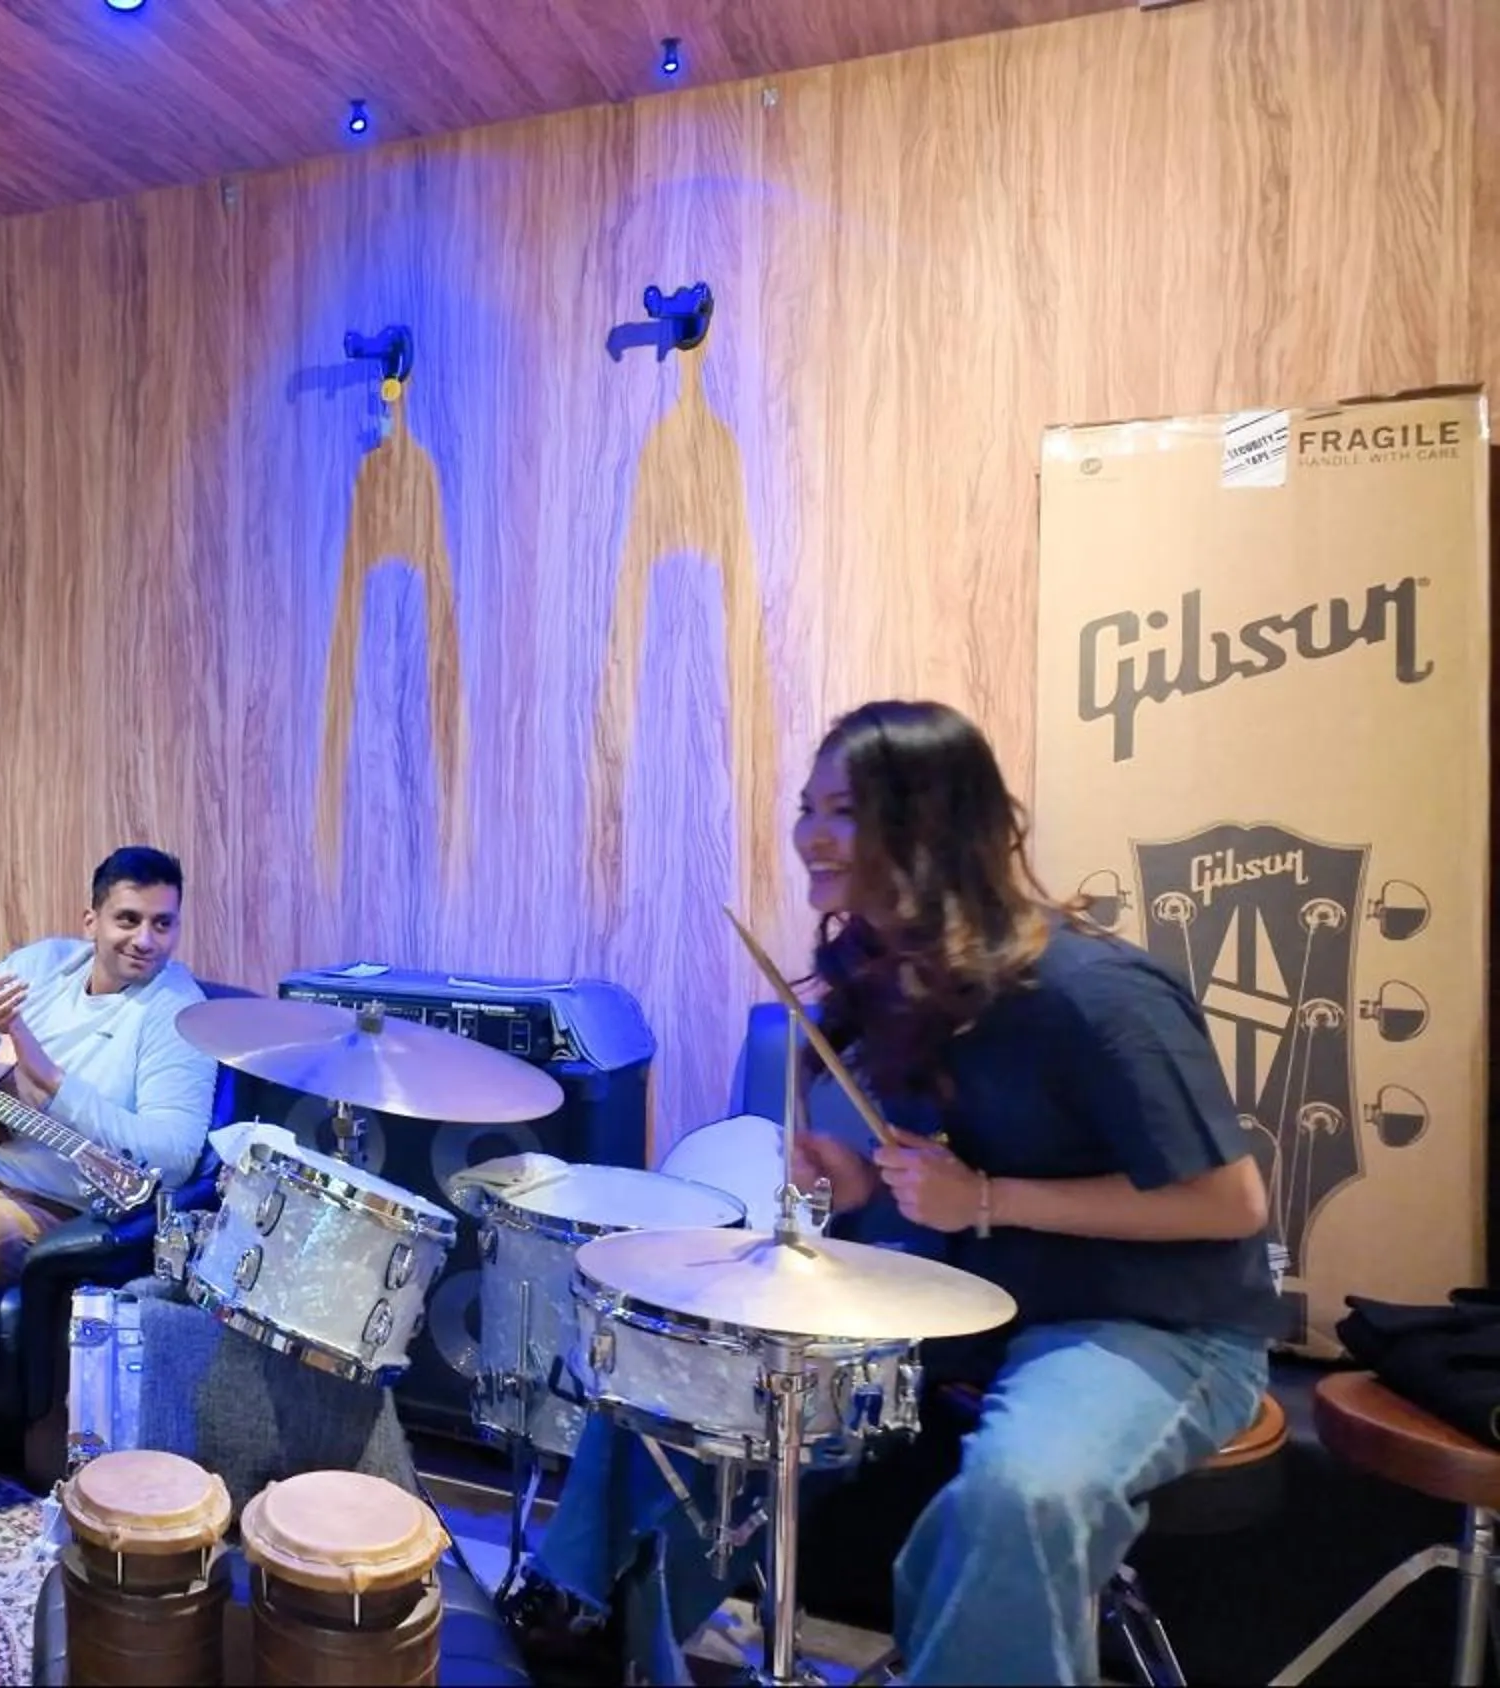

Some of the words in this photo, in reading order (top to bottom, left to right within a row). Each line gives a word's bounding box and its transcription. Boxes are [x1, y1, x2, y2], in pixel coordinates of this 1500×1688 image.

[1299, 421, 1461, 454] FRAGILE
[1299, 454, 1359, 467] HANDLE
[1370, 451, 1411, 464] WITH
[1416, 447, 1460, 462] CARE
[1078, 577, 1434, 763] Gibson
[1191, 848, 1309, 907] Gibson
